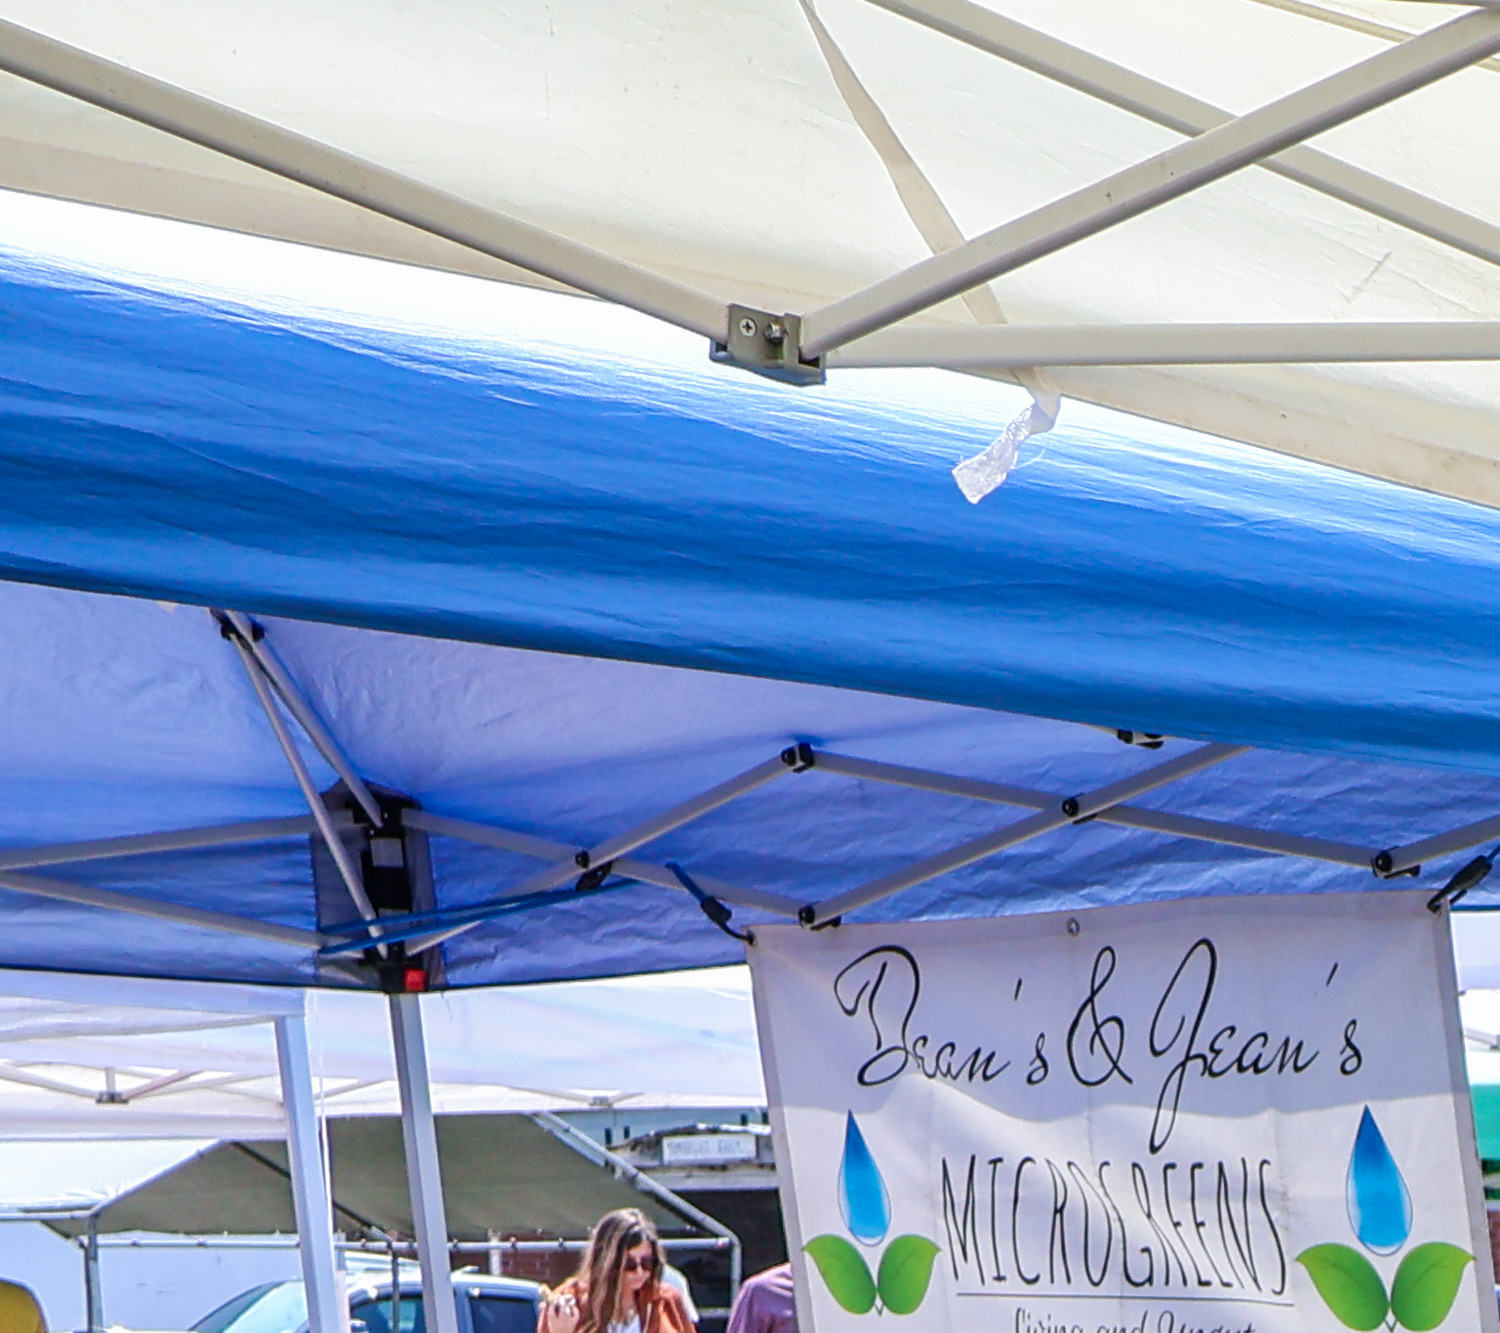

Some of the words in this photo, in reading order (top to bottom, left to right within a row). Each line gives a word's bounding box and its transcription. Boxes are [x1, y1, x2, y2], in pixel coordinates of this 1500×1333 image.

[834, 945, 1048, 1086] Dean's
[1066, 945, 1134, 1085] &
[1148, 938, 1363, 1153] Jean's
[941, 1155, 1288, 1297] MICROGREENS
